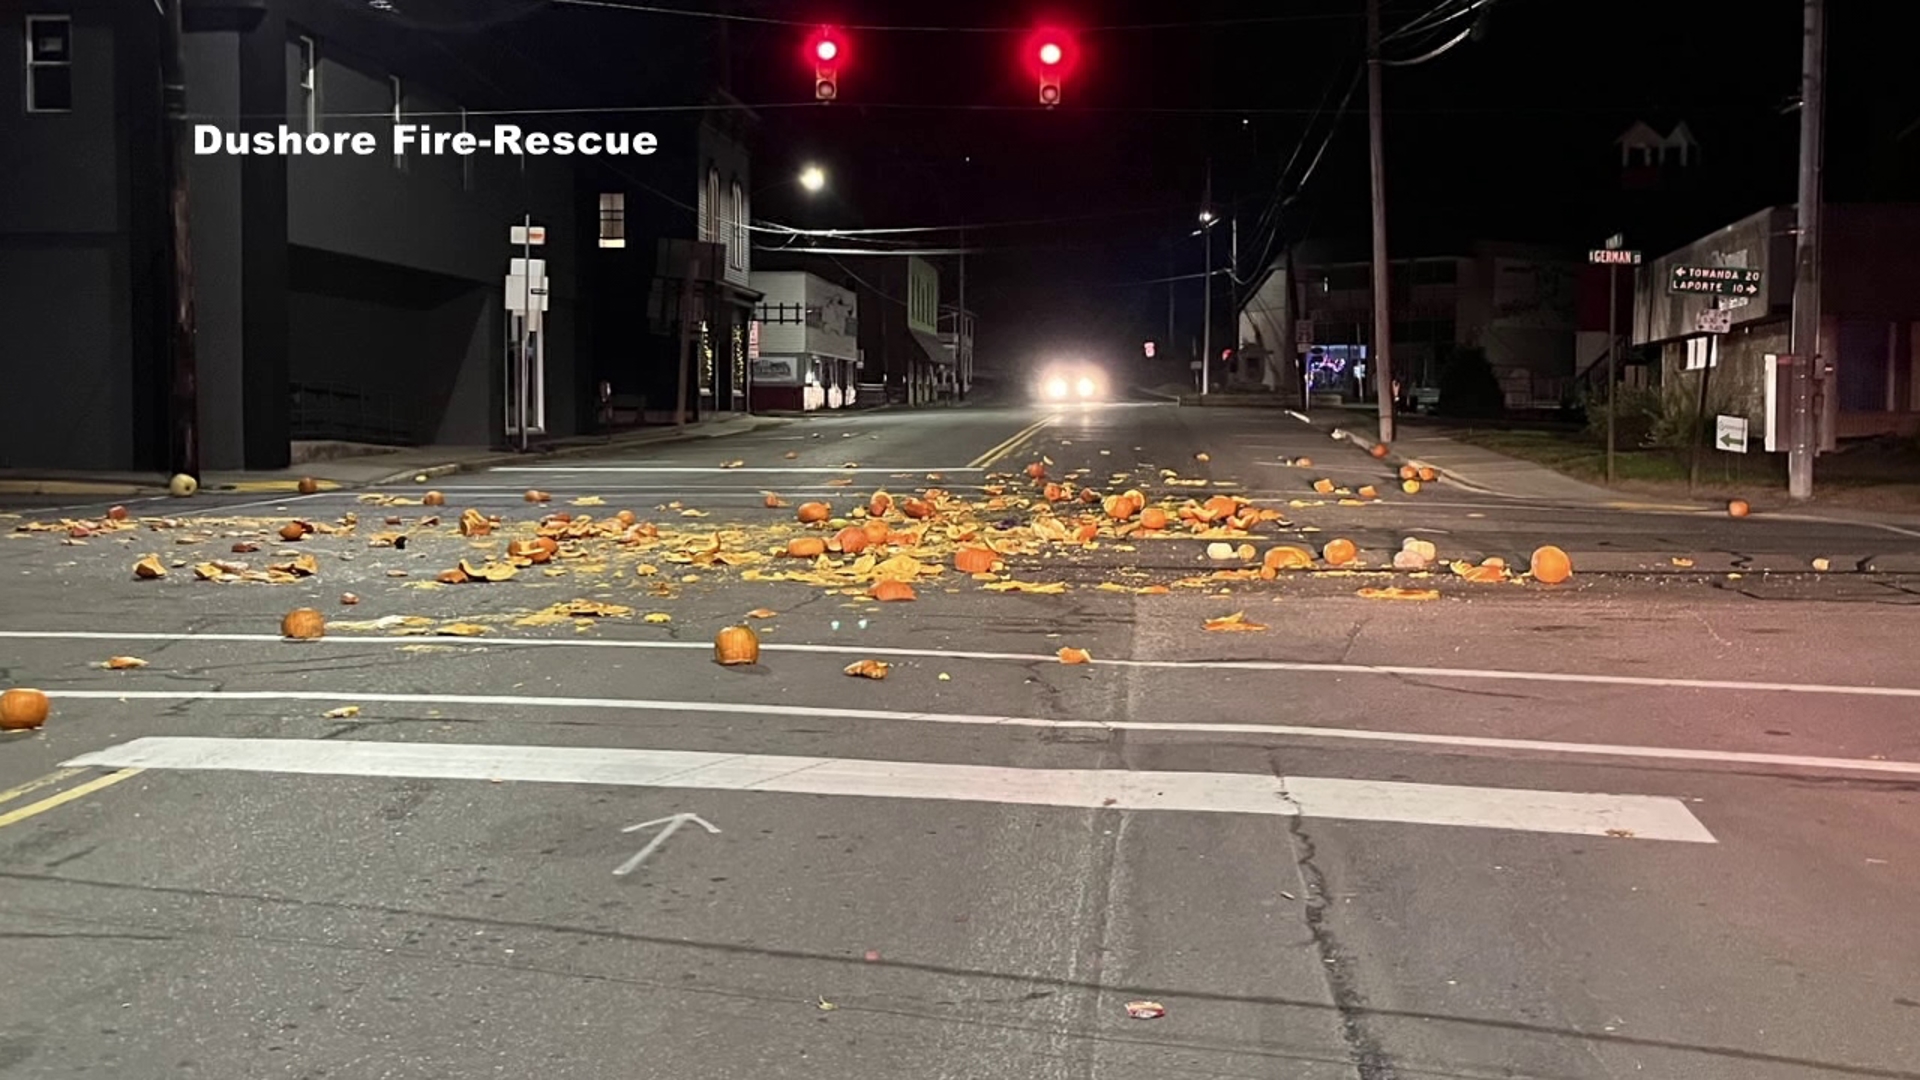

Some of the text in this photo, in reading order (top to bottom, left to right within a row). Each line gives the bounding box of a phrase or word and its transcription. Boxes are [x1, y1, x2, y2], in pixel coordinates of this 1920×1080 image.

[1594, 250, 1631, 263] GERMAN
[1689, 268, 1760, 281] TOWANDA 20
[1673, 280, 1744, 293] LAPORTE 10
